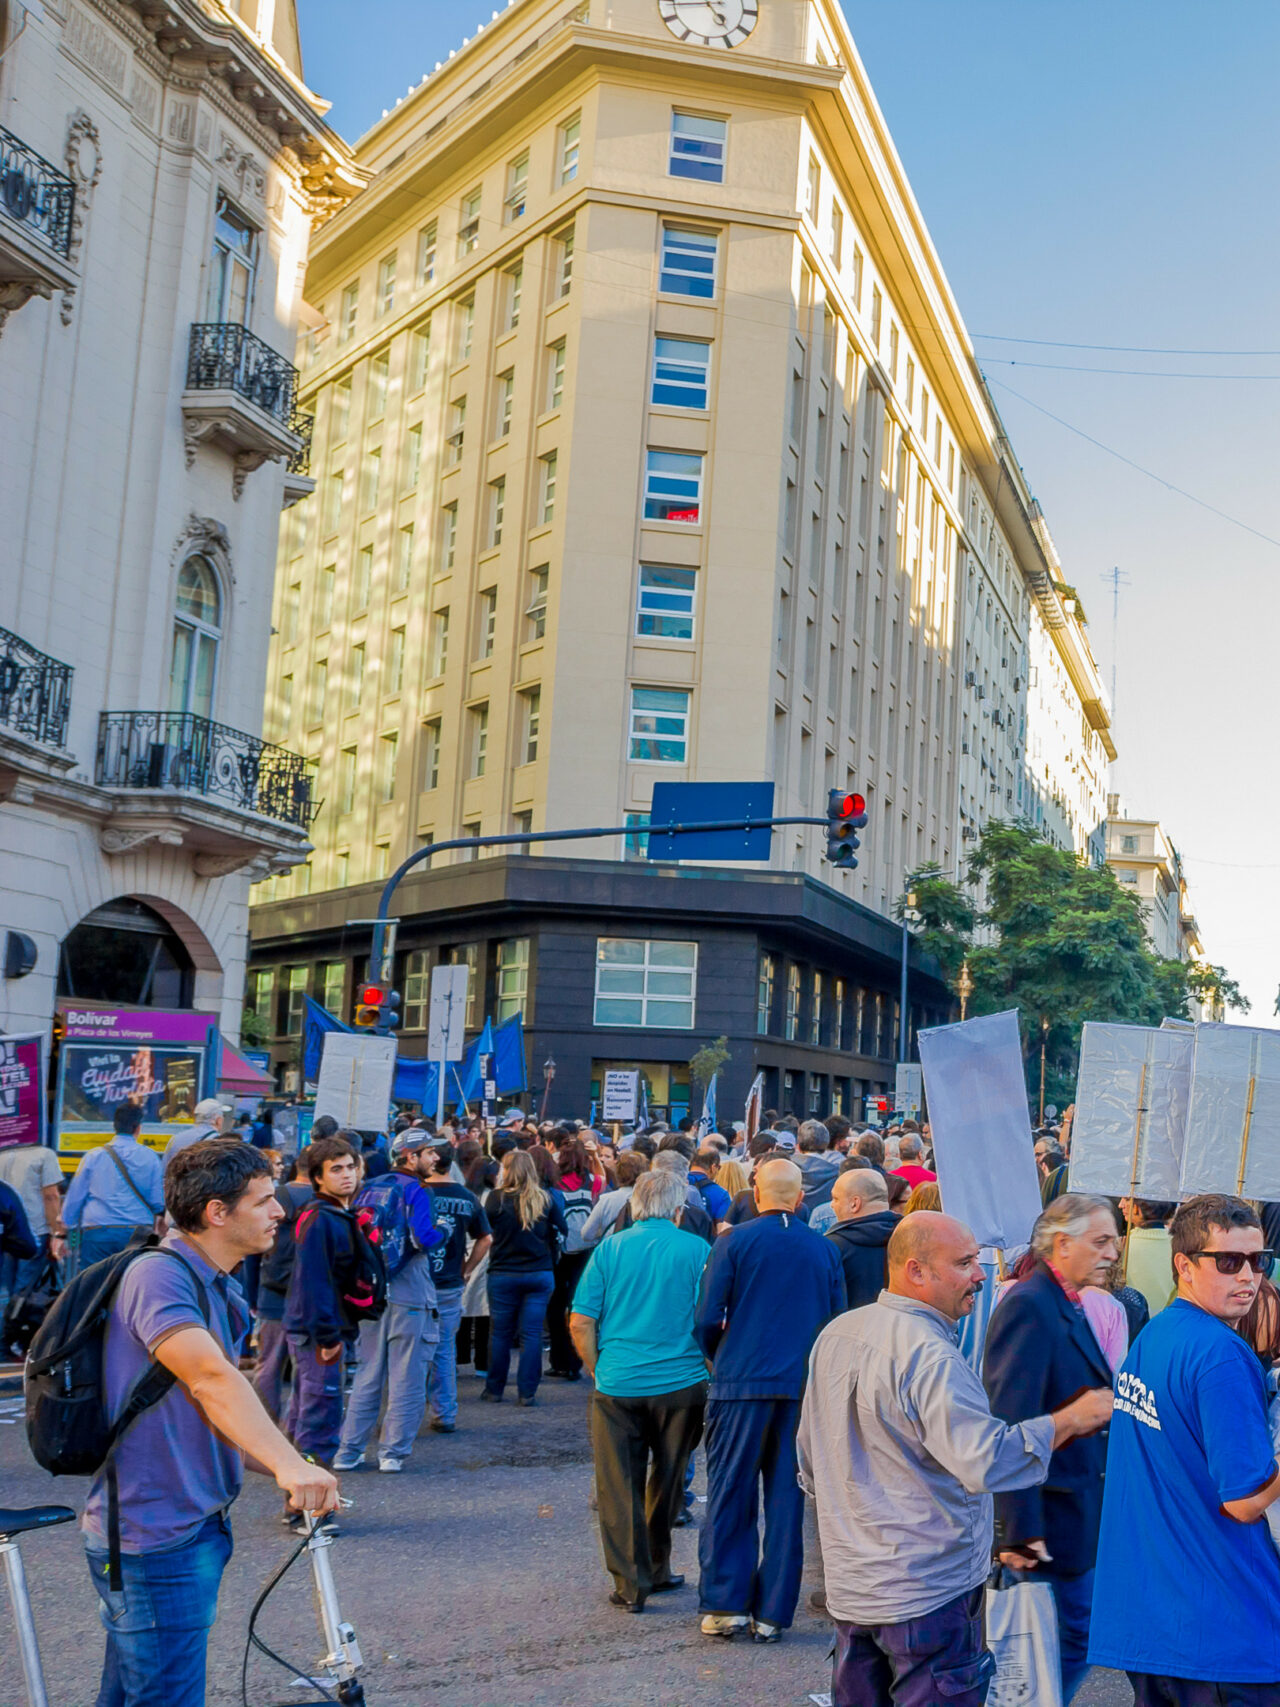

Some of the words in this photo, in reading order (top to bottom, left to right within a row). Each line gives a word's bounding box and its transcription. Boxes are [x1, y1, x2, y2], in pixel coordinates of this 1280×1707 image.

[74, 1028, 95, 1036] Plaza
[96, 1029, 107, 1037] de
[108, 1029, 120, 1037] los
